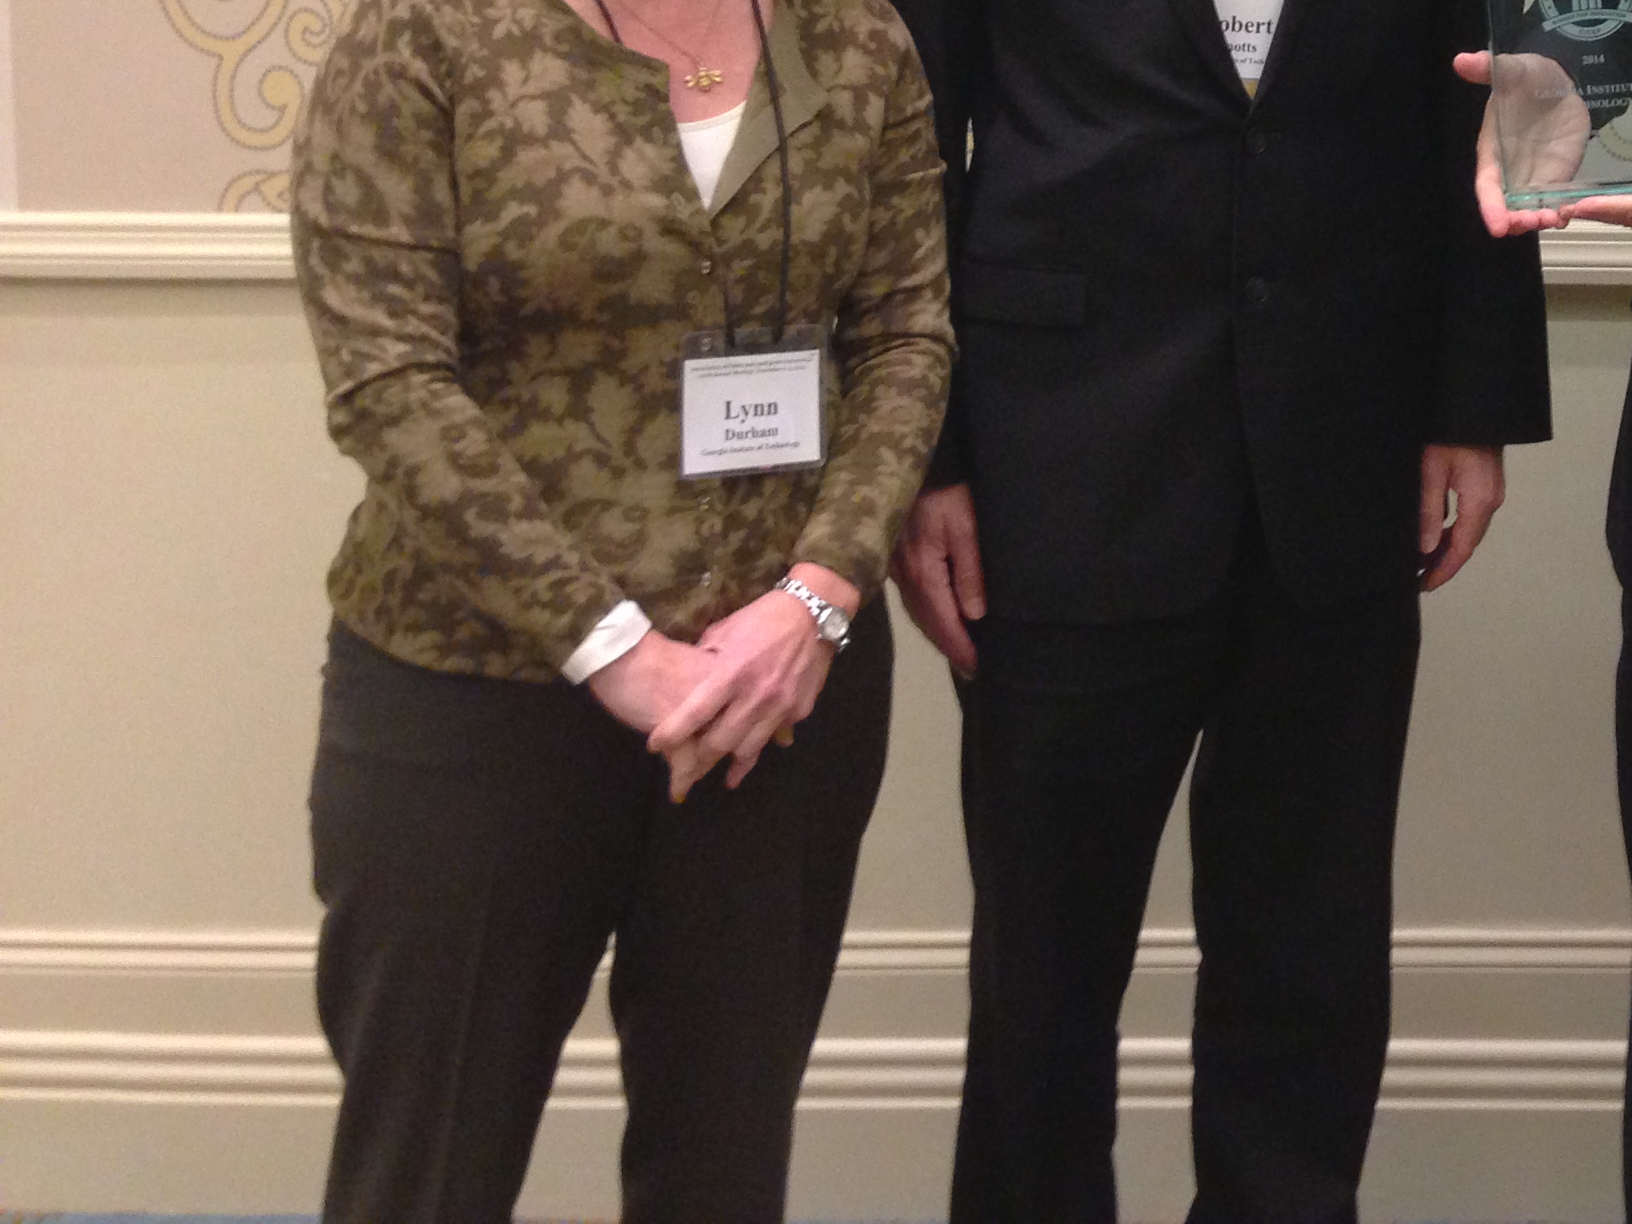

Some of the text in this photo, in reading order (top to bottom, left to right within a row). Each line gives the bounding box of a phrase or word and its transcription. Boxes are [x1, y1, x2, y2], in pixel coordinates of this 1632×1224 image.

[1219, 15, 1273, 34] obert
[1581, 53, 1606, 66] 2014
[724, 400, 779, 424] Lynn
[724, 427, 779, 441] Durham
